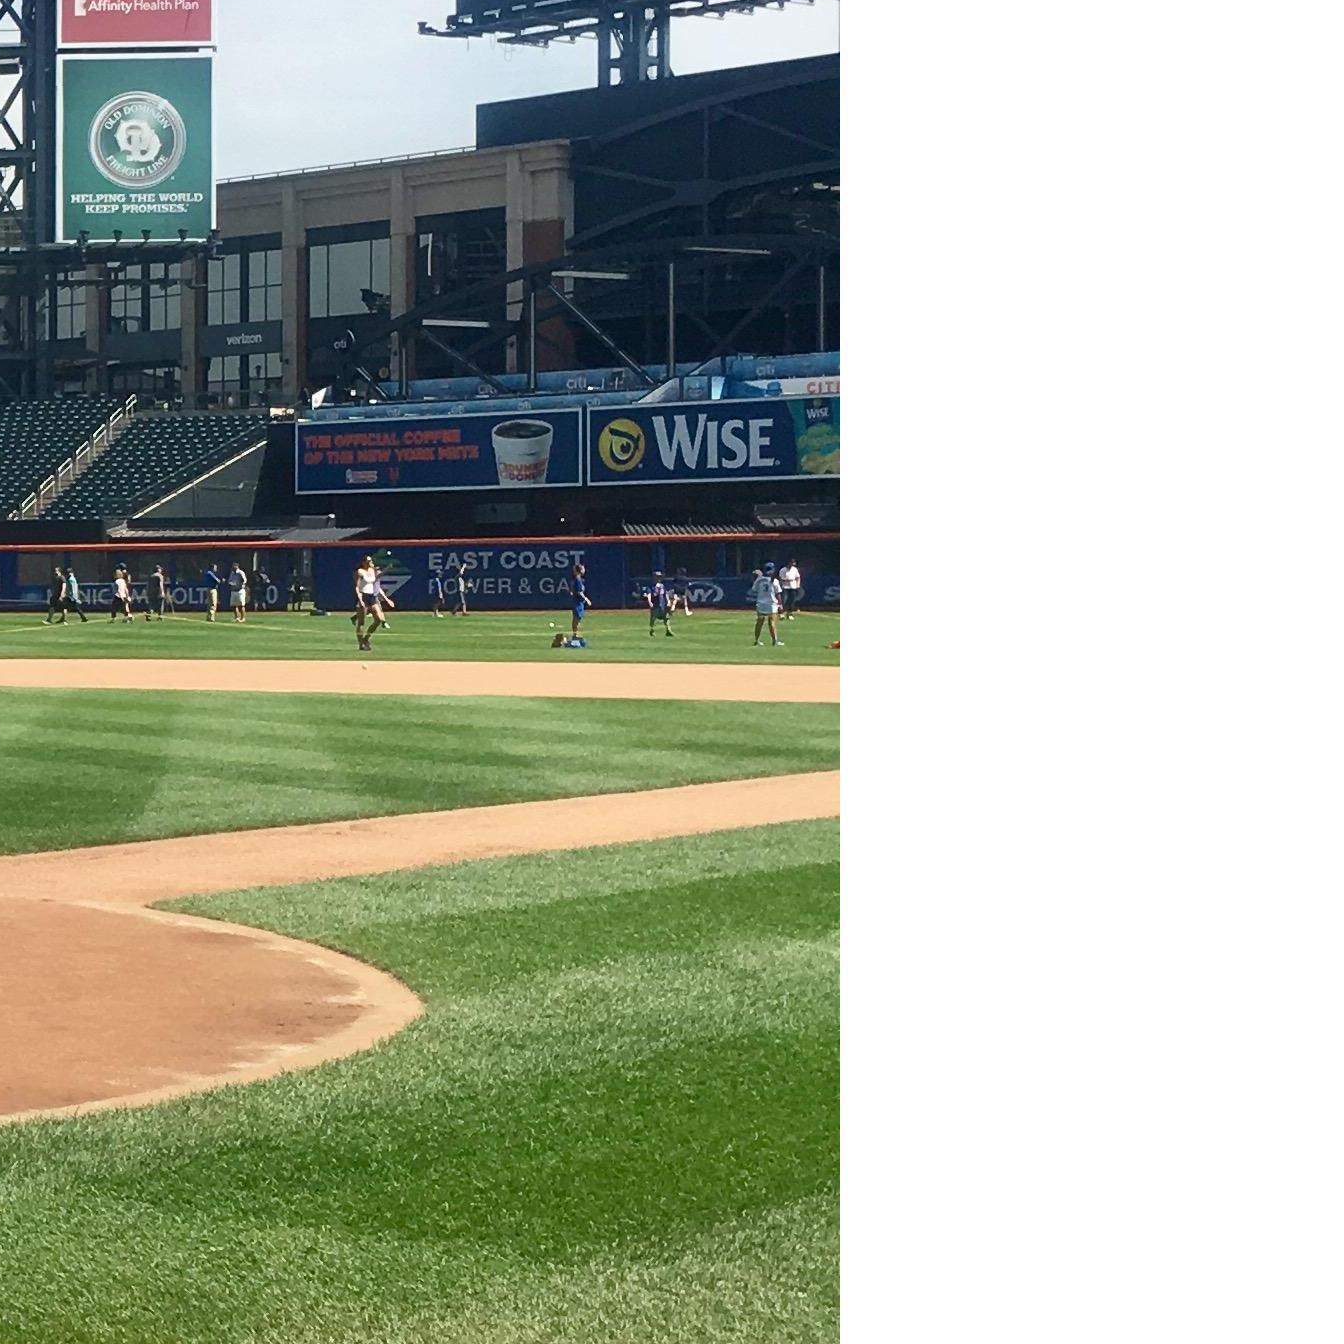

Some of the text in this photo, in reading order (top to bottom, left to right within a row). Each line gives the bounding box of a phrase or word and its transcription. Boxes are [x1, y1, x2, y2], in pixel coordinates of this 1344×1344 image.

[104, 110, 123, 131] OLD
[106, 154, 169, 177] FREIGHT LINE
[70, 192, 204, 204] HELPING THE WORLD
[85, 205, 119, 214] KEEP
[226, 333, 262, 346] verizon
[806, 406, 829, 420] WISE
[652, 413, 775, 470] WISE
[428, 550, 585, 570] EAST COAST
[518, 577, 534, 594] &
[538, 577, 574, 594] GA
